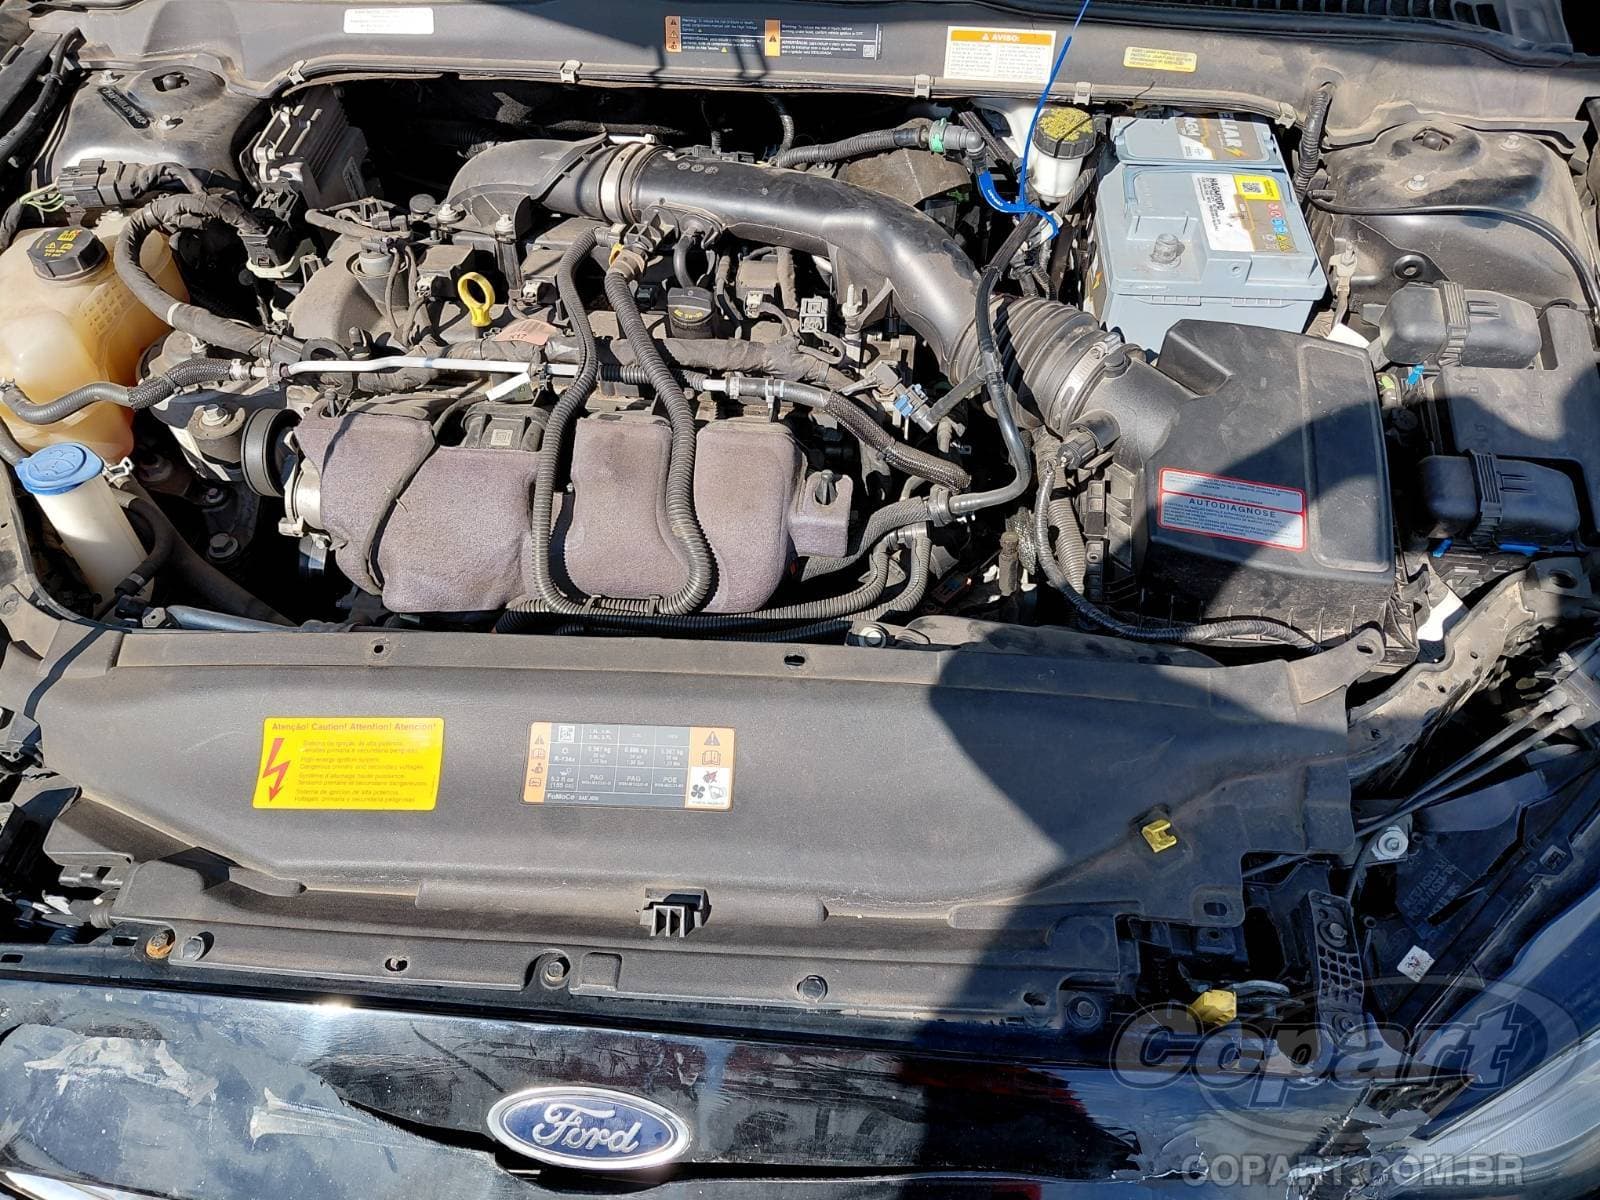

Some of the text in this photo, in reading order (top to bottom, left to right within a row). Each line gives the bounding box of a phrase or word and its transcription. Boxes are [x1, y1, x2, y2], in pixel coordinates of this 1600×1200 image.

[1188, 497, 1277, 519] AUTODIAGNOSE
[271, 722, 309, 731] Atenção!
[311, 722, 348, 731] Caution!
[350, 722, 393, 731] Attention!
[531, 1102, 642, 1154] Ford
